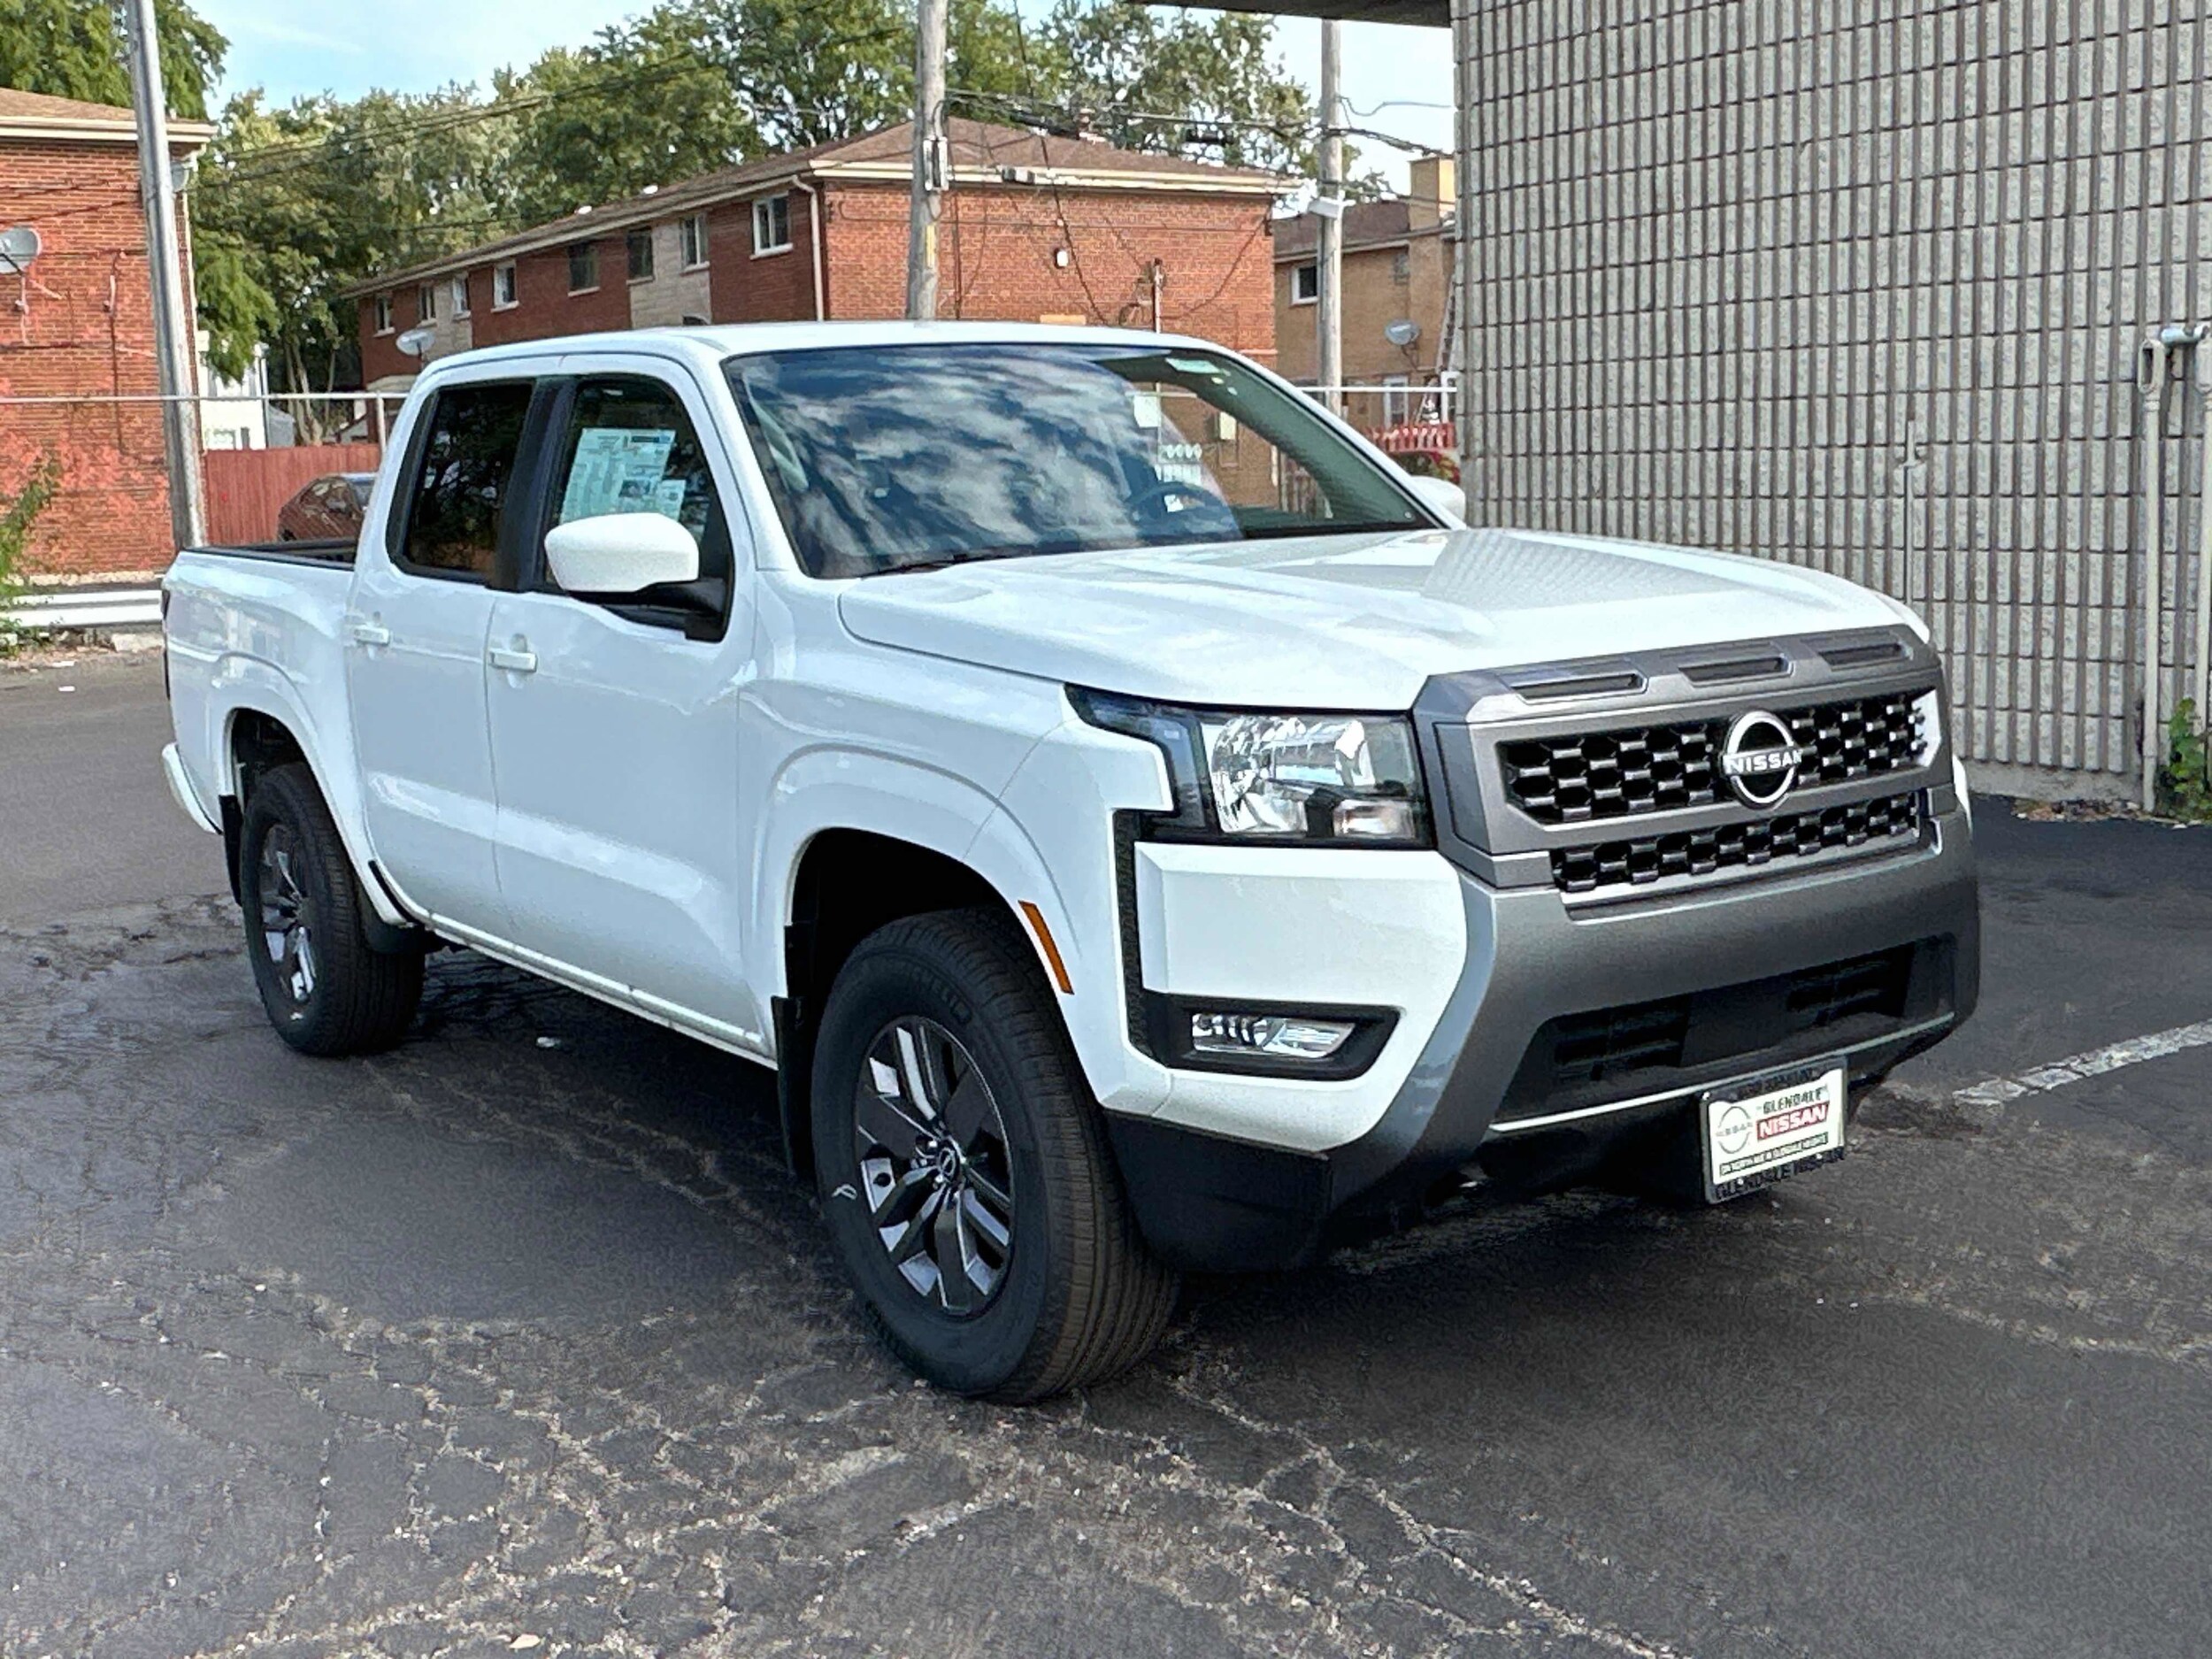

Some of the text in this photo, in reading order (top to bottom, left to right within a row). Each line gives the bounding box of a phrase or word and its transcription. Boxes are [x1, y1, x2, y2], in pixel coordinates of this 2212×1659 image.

[1724, 749, 1802, 775] NISSAN
[1762, 1087, 1823, 1115] GLENDALE
[1758, 1103, 1828, 1139] NISSAN
